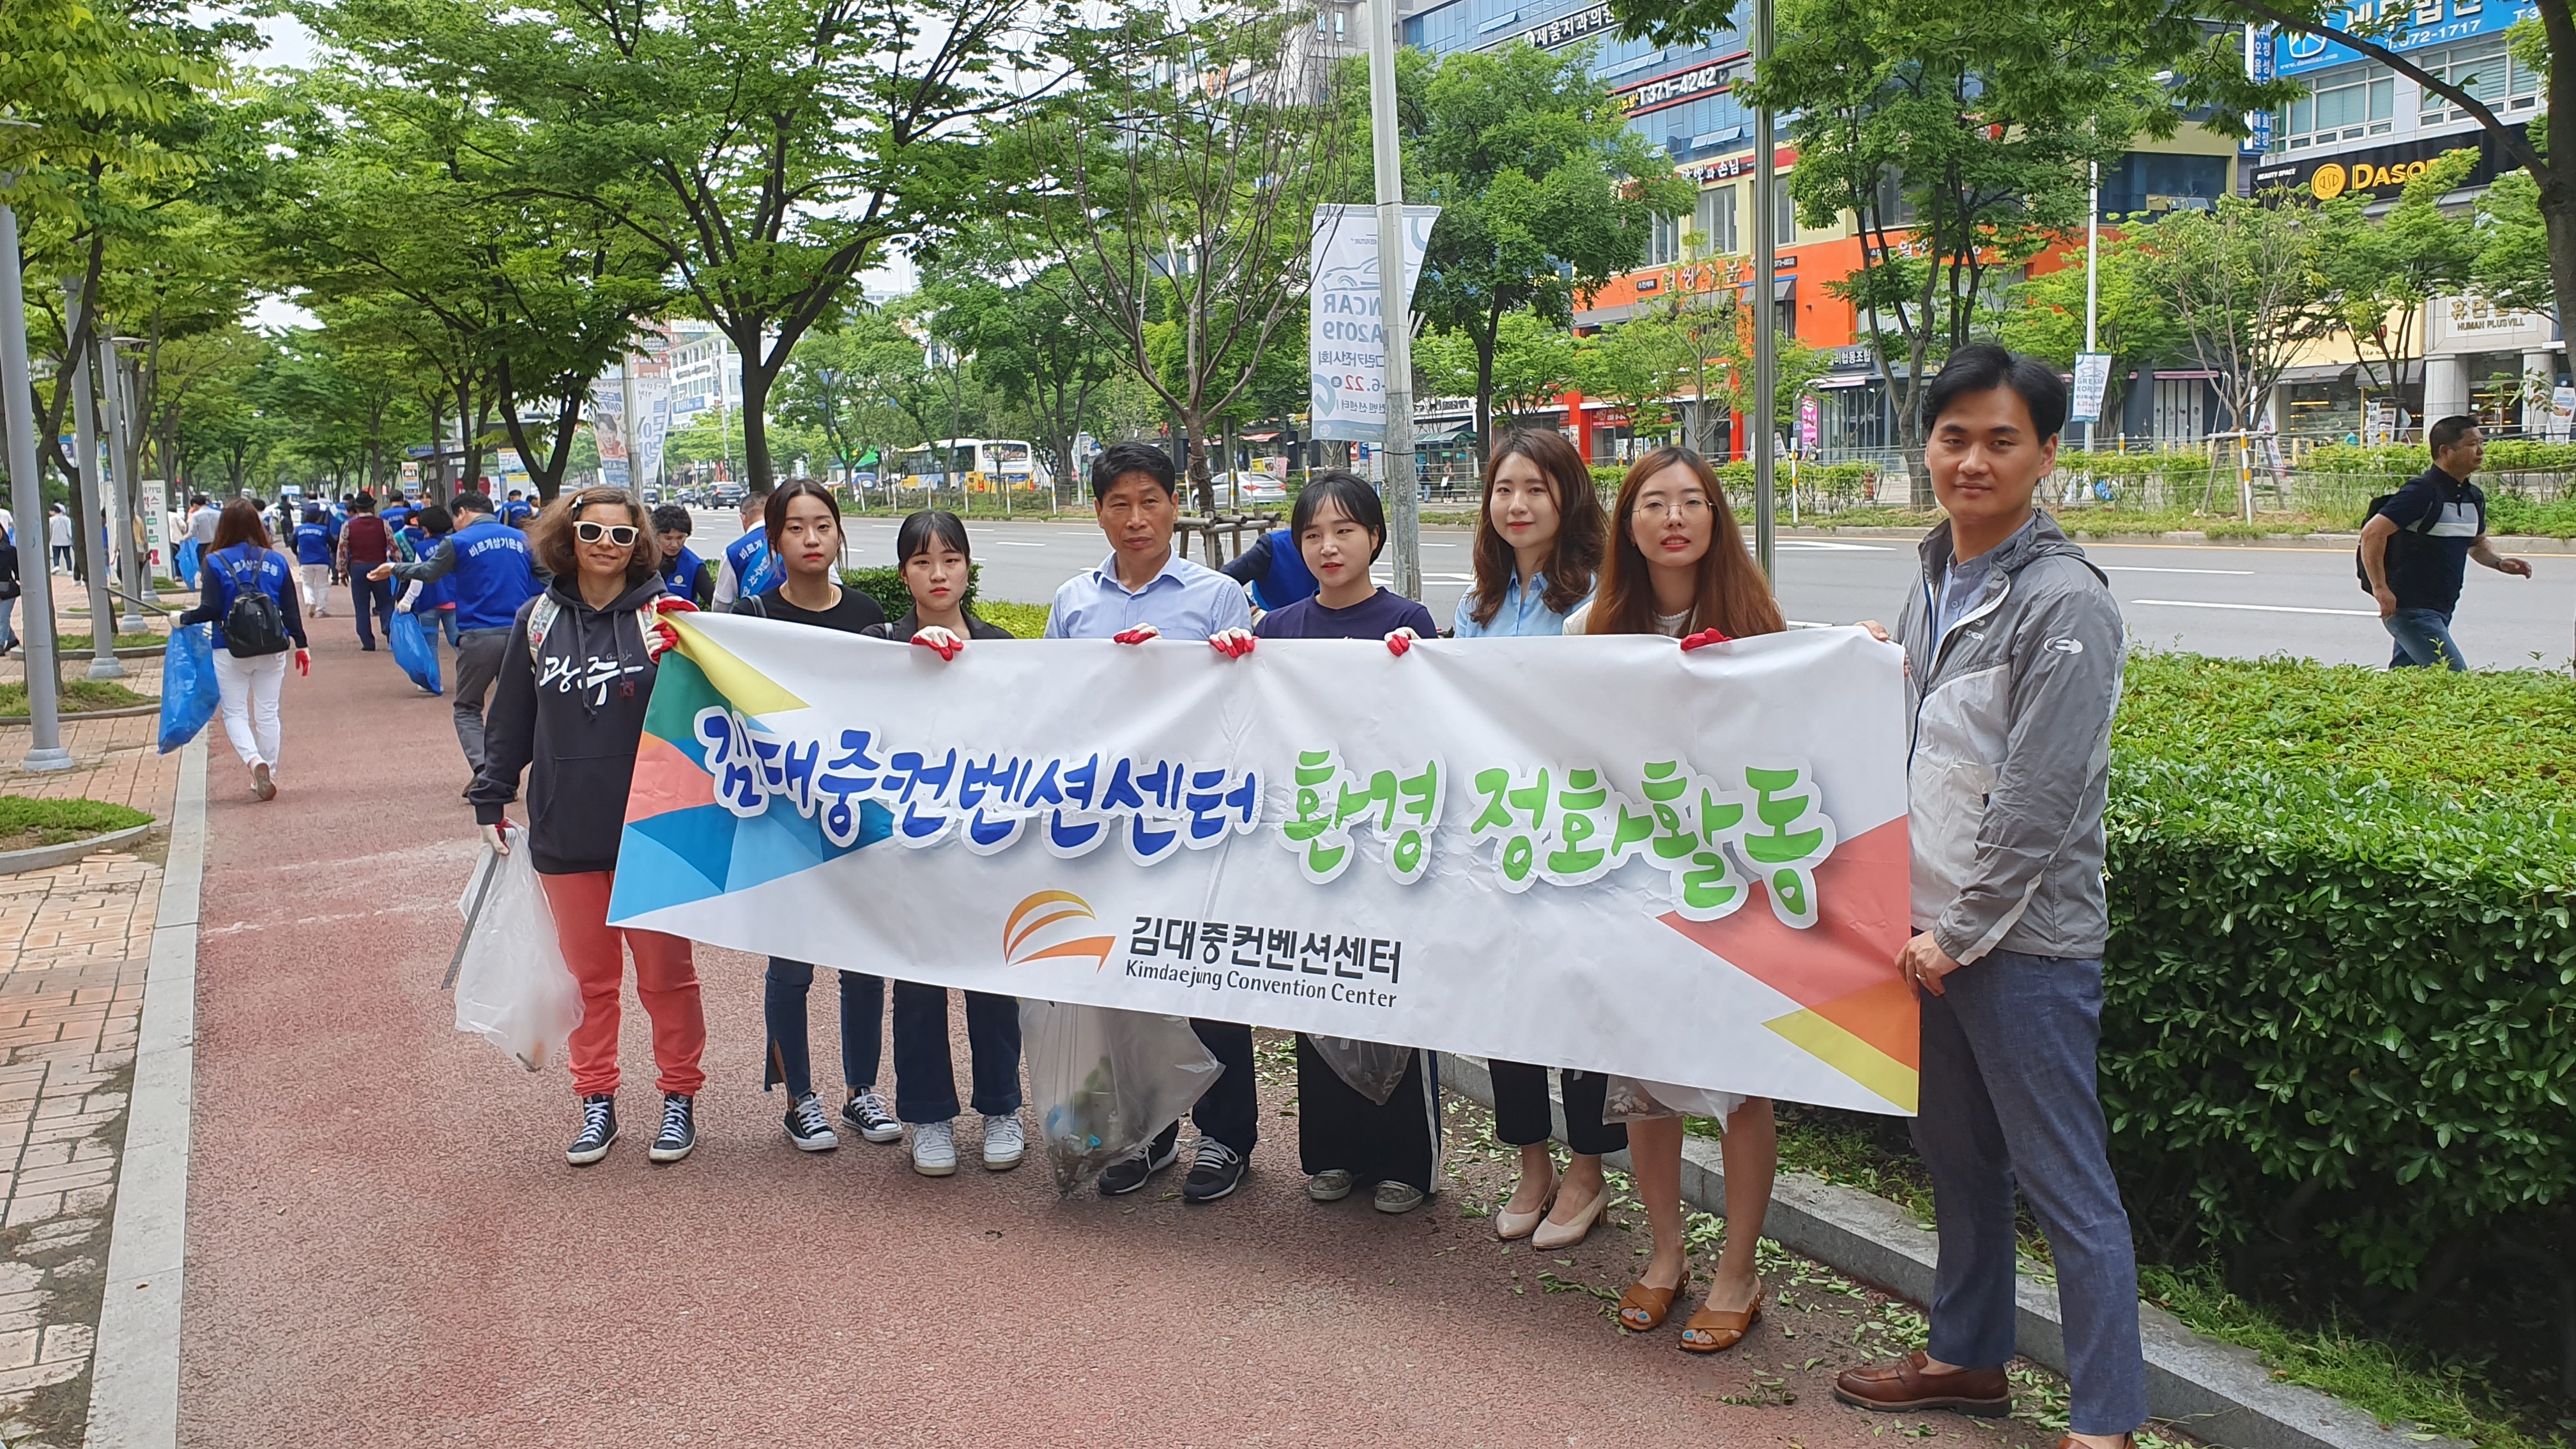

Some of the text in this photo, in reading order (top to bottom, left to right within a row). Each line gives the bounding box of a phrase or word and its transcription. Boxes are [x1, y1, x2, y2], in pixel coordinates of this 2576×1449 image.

[2257, 168, 2296, 180] BEAUTY SPACE
[2457, 321, 2485, 331] HUMAN
[468, 536, 524, 558] 바르게살기운동
[703, 714, 1823, 916] 김대중컨벤션센터 환경 정화활동
[1130, 916, 1402, 985] 김대중컨벤션센터
[1126, 960, 1398, 1009] Kimdaejung Convention Center
